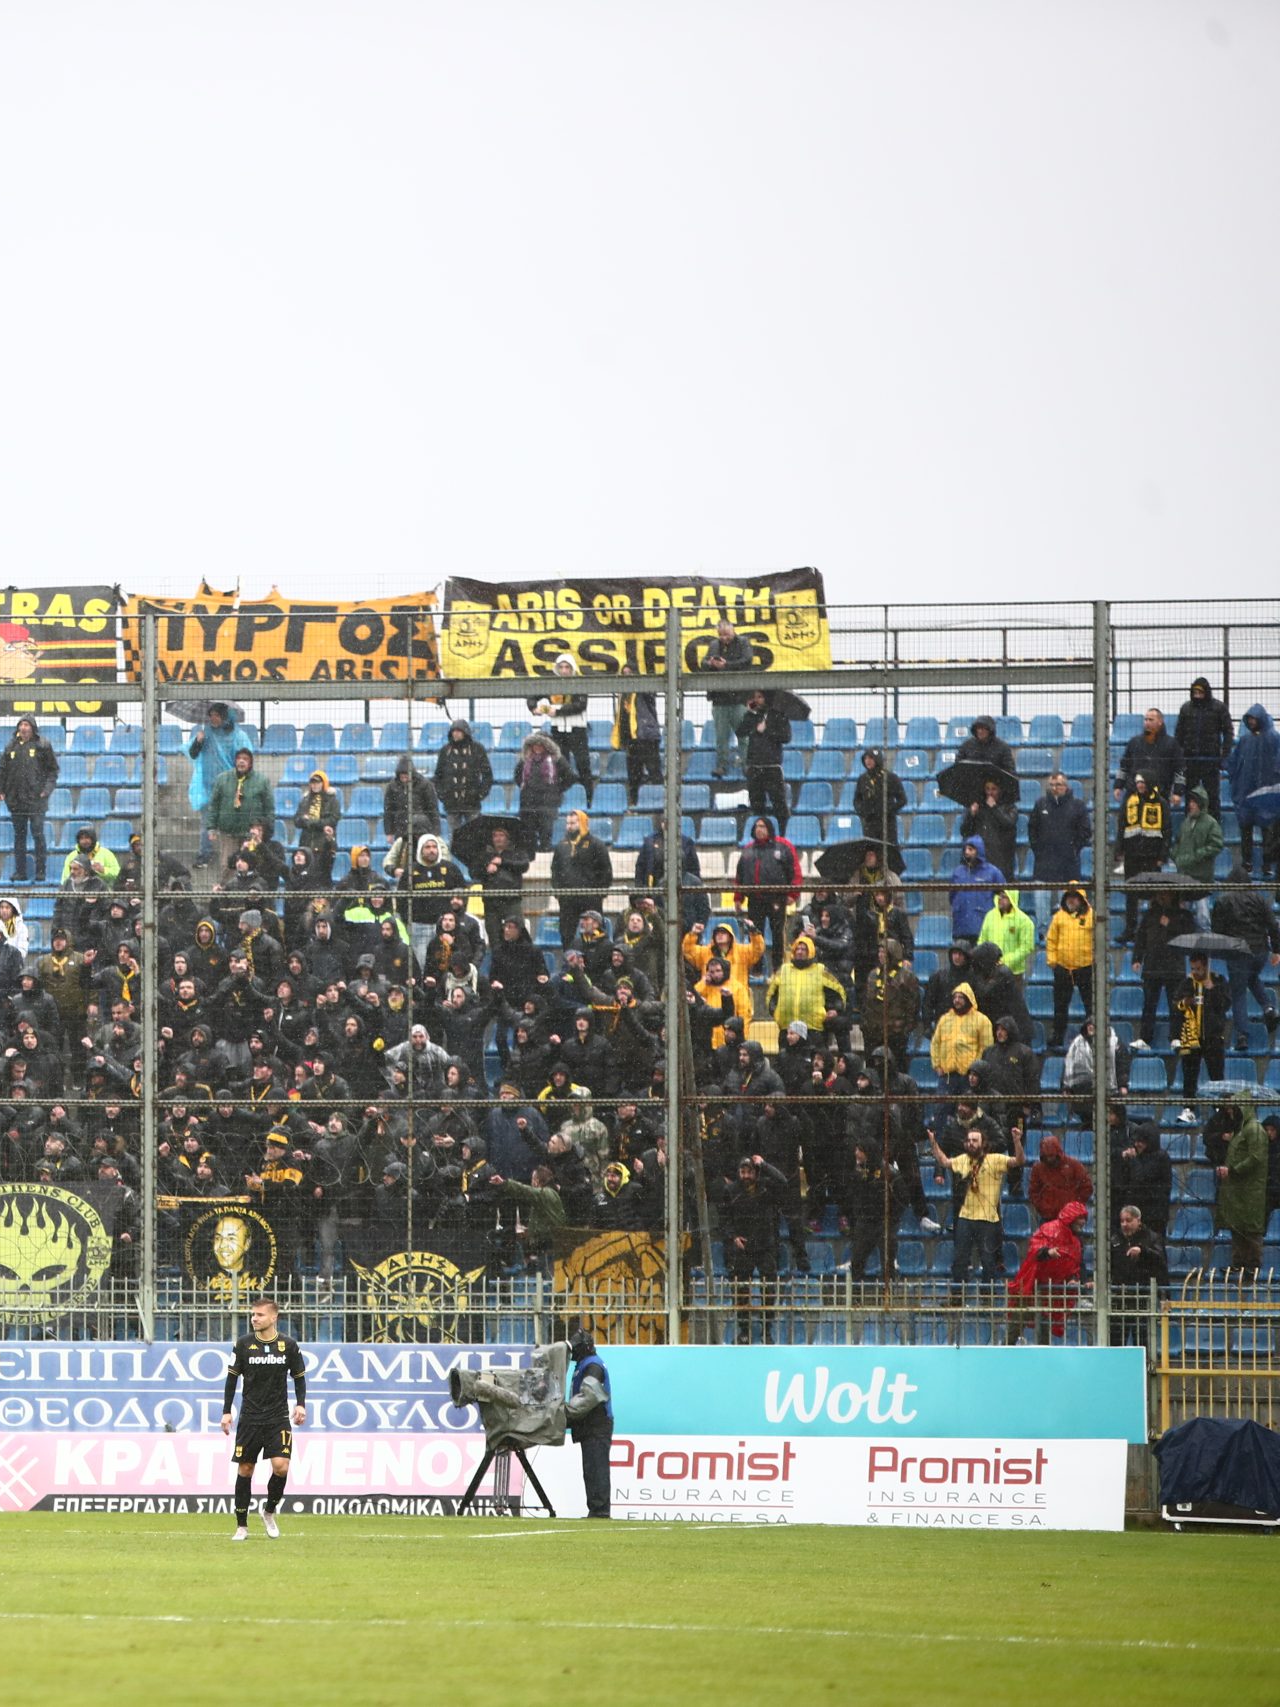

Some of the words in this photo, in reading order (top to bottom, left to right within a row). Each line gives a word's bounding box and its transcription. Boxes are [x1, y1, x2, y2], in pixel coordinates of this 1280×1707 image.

[492, 588, 584, 632] ARIS
[592, 594, 632, 626] OR
[642, 585, 771, 629] DEATH
[156, 658, 288, 682] VAMOS
[66, 1196, 100, 1229] CLUB
[389, 1253, 448, 1270] ΑΡΗΣ
[248, 1354, 286, 1365] novibet
[765, 1366, 917, 1424] Wolt
[280, 1430, 292, 1446] 17
[54, 1439, 508, 1487] ΚΡΑΤΜΕΝΟΣ
[868, 1446, 1048, 1485] Promist
[615, 1488, 794, 1502] NSURANCE
[868, 1491, 1047, 1504] INSURANCE
[54, 1498, 189, 1514] ΕΠΕΞΕΡΓΑΣΙΑ
[313, 1498, 445, 1516] ΟΙΚΟΔΟΜΙΚΑ
[867, 1513, 878, 1524] &
[892, 1513, 999, 1525] FINANCE
[1011, 1514, 1046, 1526] S.A.
